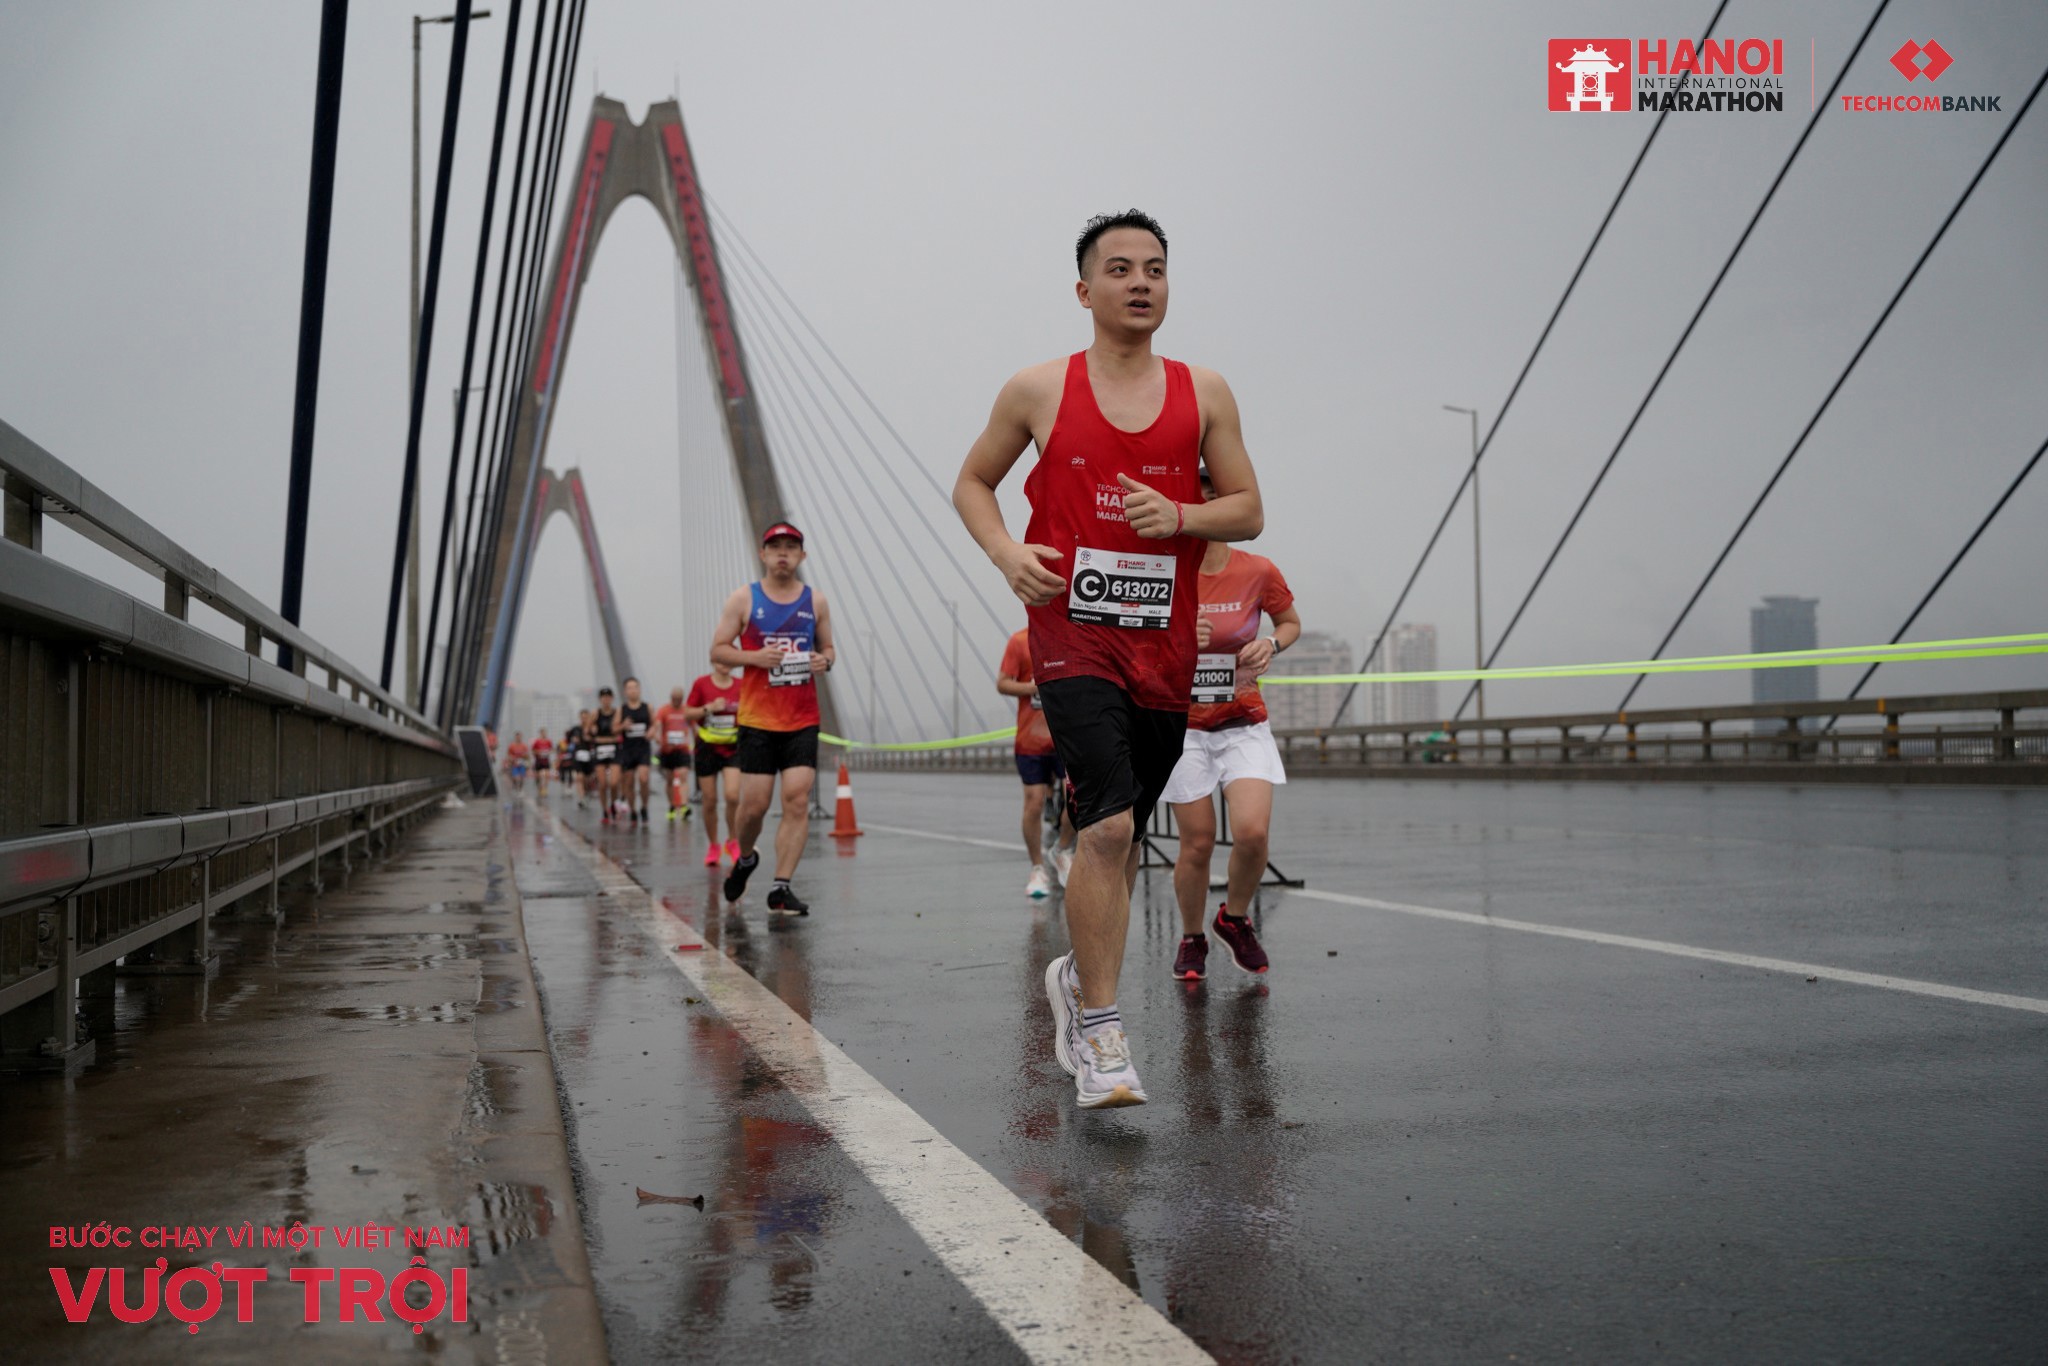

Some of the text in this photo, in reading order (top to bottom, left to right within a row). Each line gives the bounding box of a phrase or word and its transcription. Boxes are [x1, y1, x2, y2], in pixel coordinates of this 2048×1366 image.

[1096, 511, 1129, 523] MARA
[1080, 575, 1169, 599] C 613072
[1071, 613, 1102, 622] MARATHON
[1193, 671, 1230, 683] 611001
